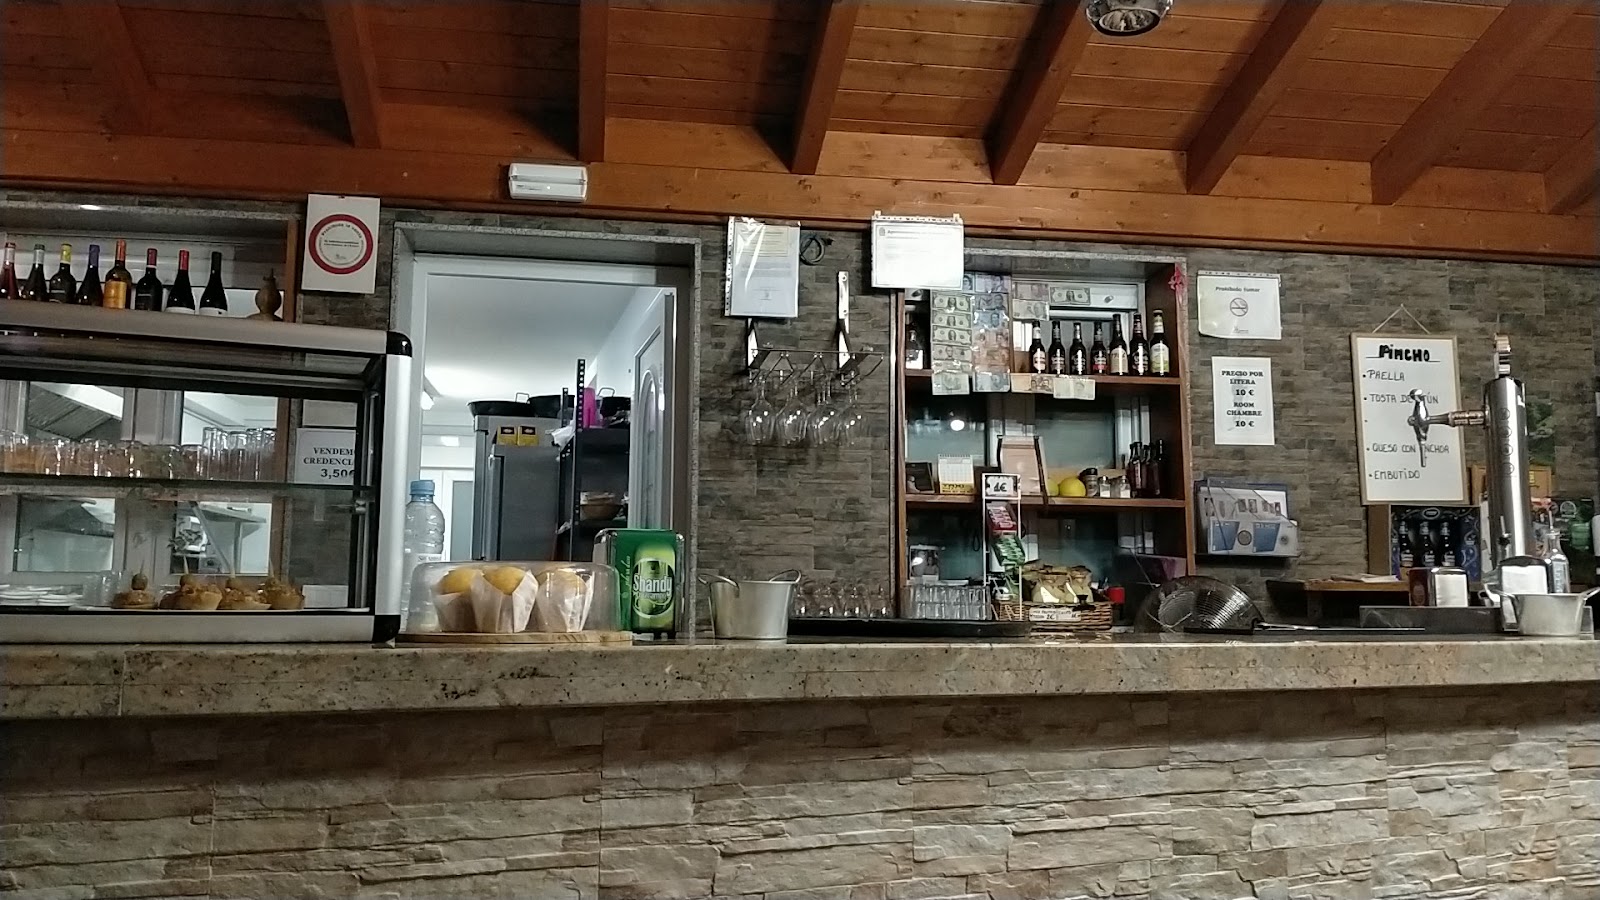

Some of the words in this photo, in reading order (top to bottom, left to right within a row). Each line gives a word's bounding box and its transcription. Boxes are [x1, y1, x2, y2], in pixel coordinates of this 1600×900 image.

[1367, 369, 1405, 381] PAELLA
[1369, 393, 1397, 403] TOSTA
[313, 447, 354, 456] VENDEM
[1372, 443, 1398, 453] QUESO
[1401, 444, 1416, 453] CON
[1421, 443, 1450, 454] NCHOA
[303, 457, 354, 466] CREDENCI
[993, 482, 1007, 492] 1€
[633, 573, 673, 597] Shandy
